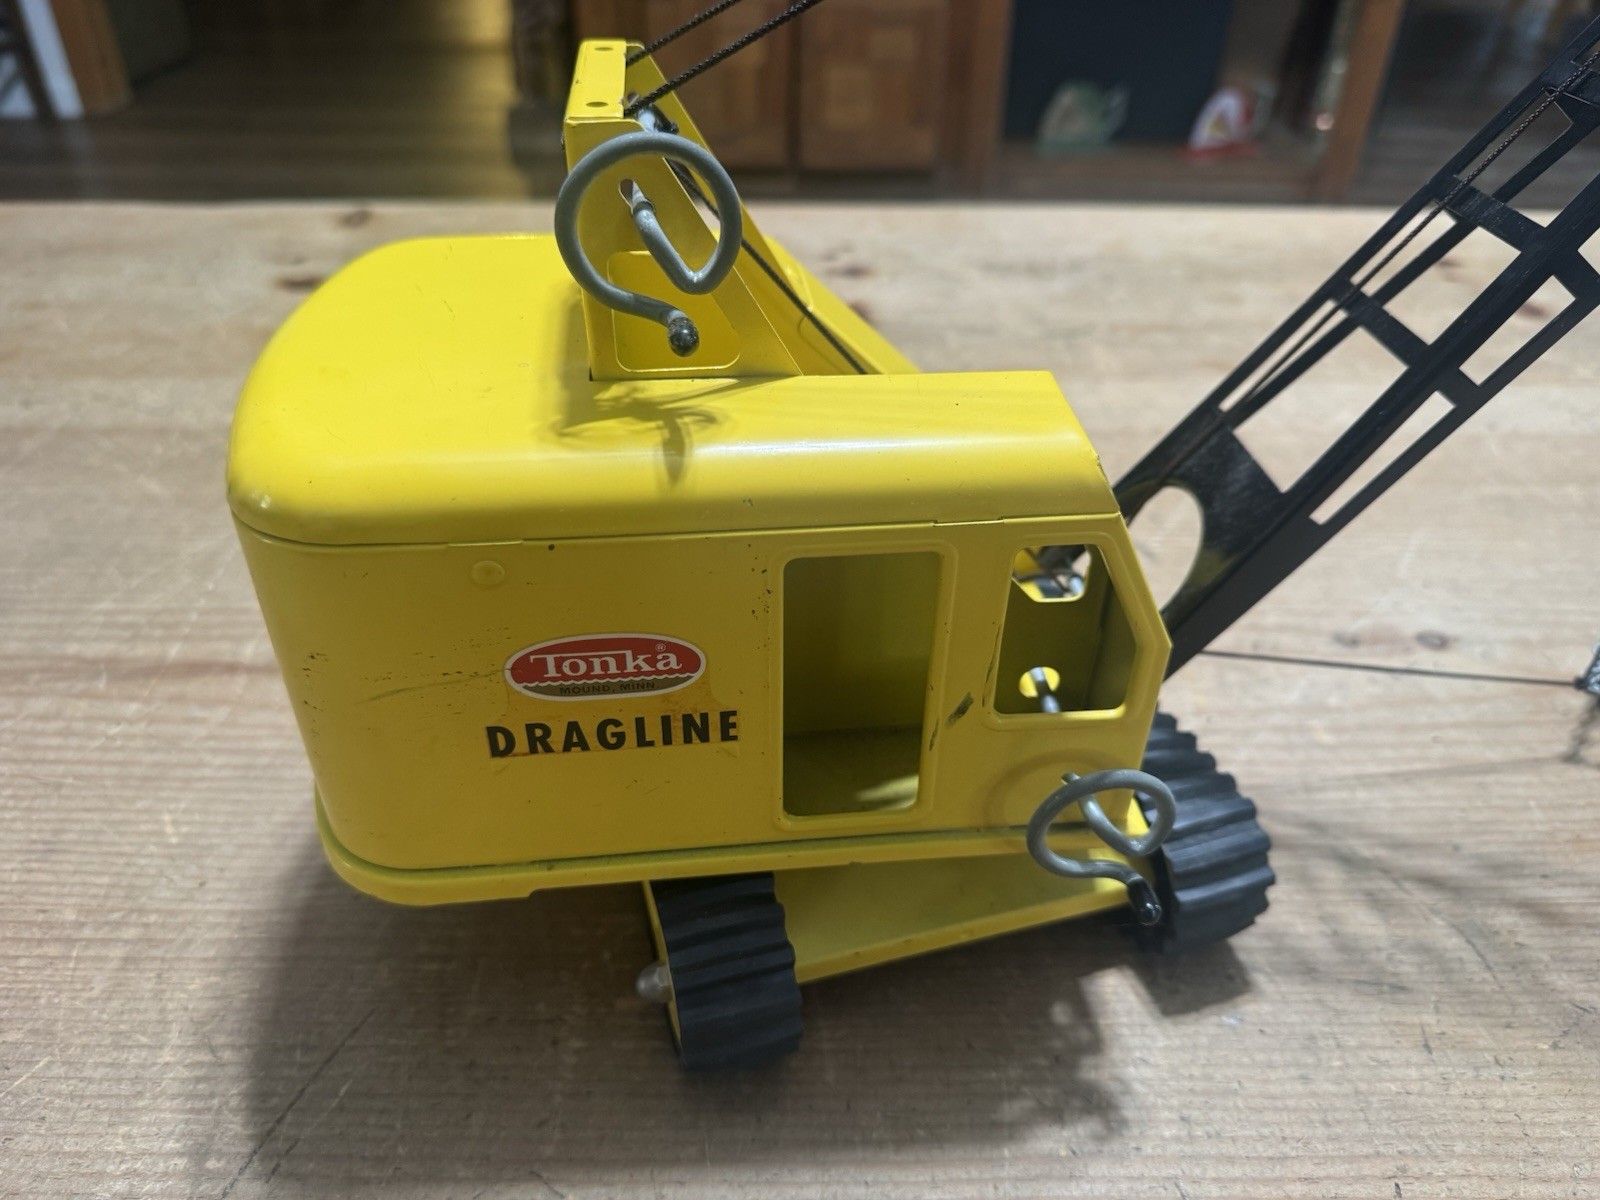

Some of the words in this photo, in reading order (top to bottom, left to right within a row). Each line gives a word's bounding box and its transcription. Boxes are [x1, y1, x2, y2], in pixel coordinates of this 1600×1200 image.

[529, 649, 683, 678] Tonka
[559, 685, 616, 695] MOUND,
[486, 710, 739, 758] DRAGLINE
